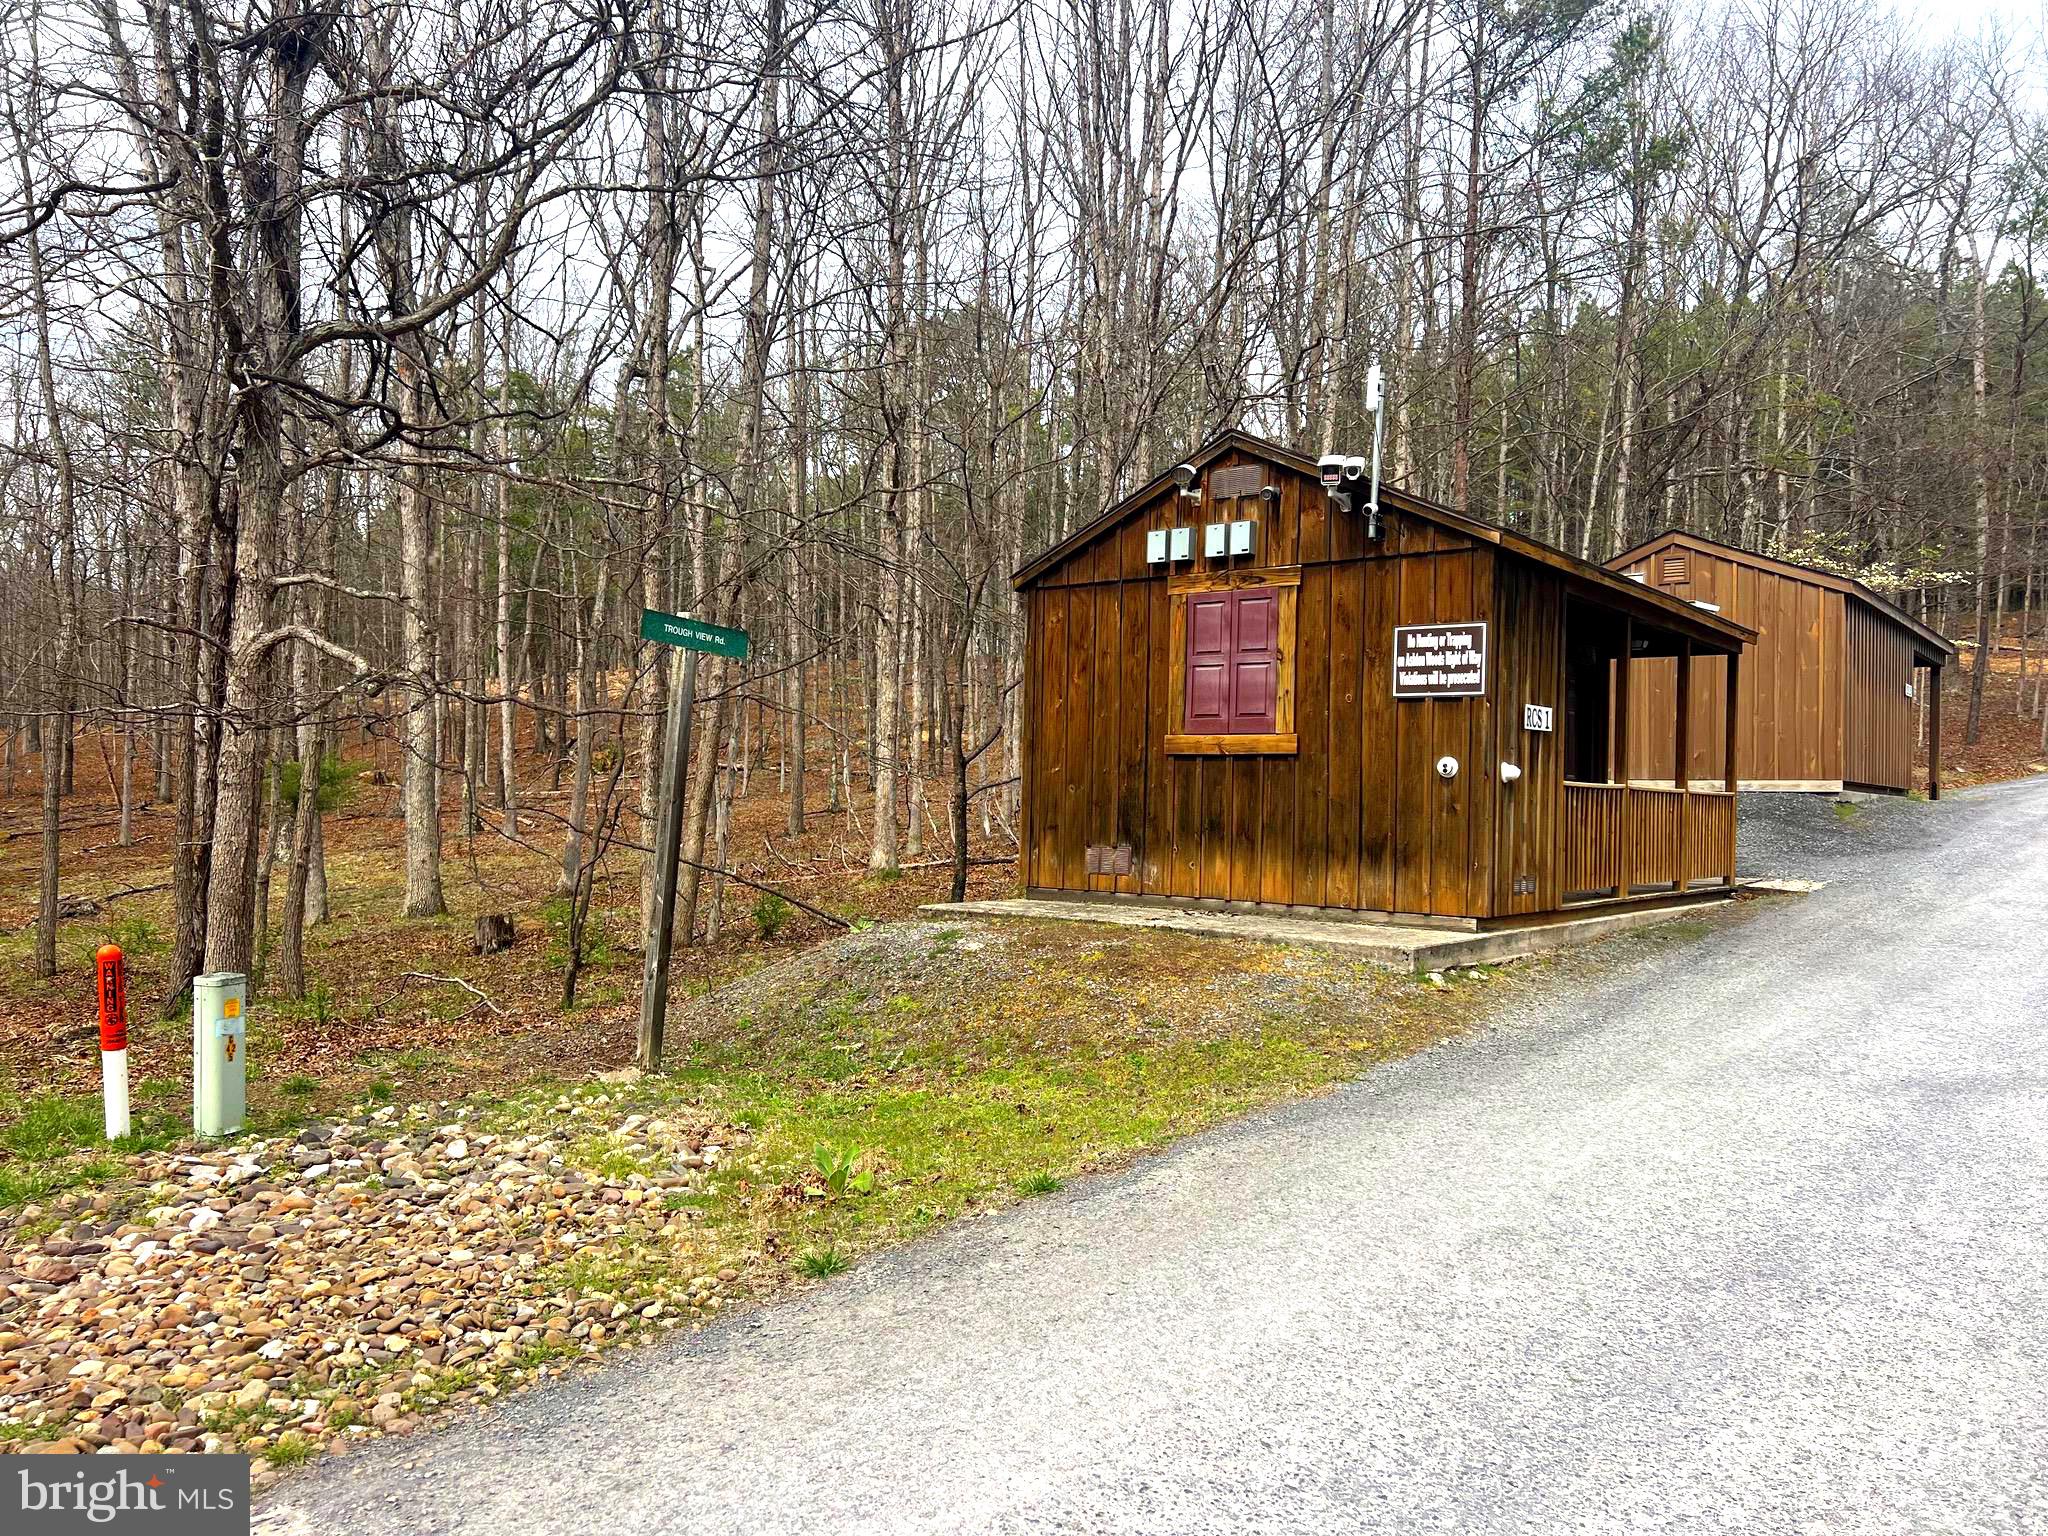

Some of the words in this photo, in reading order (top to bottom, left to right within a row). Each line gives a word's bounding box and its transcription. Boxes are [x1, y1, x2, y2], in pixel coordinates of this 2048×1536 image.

[664, 624, 693, 637] TROUGH
[695, 631, 713, 642] VIEW
[714, 635, 726, 645] Rd.
[1407, 633, 1416, 648] No
[1416, 633, 1439, 650] Hunting
[1439, 636, 1446, 647] or
[1446, 631, 1472, 650] Trapping
[1398, 656, 1405, 667] on
[1445, 651, 1461, 669] Right
[1462, 650, 1468, 665] of
[1468, 650, 1481, 668] Way
[1399, 671, 1428, 686] Violations
[1428, 670, 1439, 684] will
[1439, 669, 1447, 684] be
[1526, 707, 1543, 729] RCS
[1545, 710, 1550, 729] 1
[104, 962, 115, 1012] WARNING
